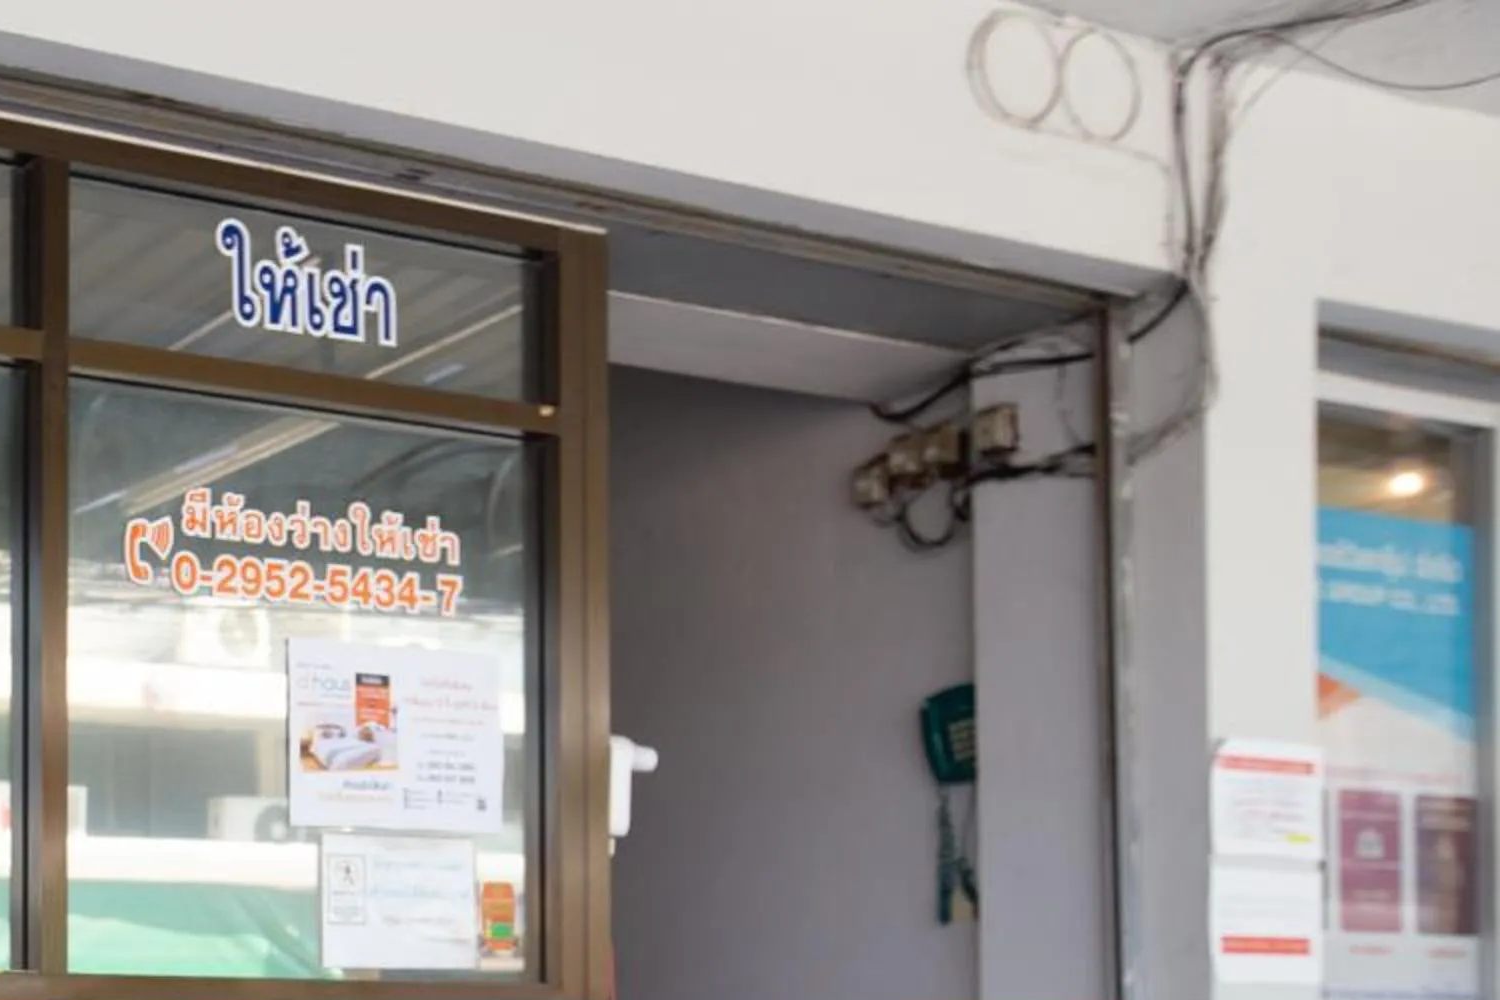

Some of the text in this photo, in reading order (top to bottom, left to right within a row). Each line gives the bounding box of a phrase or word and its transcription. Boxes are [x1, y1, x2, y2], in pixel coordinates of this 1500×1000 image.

[217, 218, 398, 347] ให้เช่า
[182, 487, 461, 566] มีห้องว่างให้เช่า
[171, 551, 463, 617] 0-2952-5434-7
